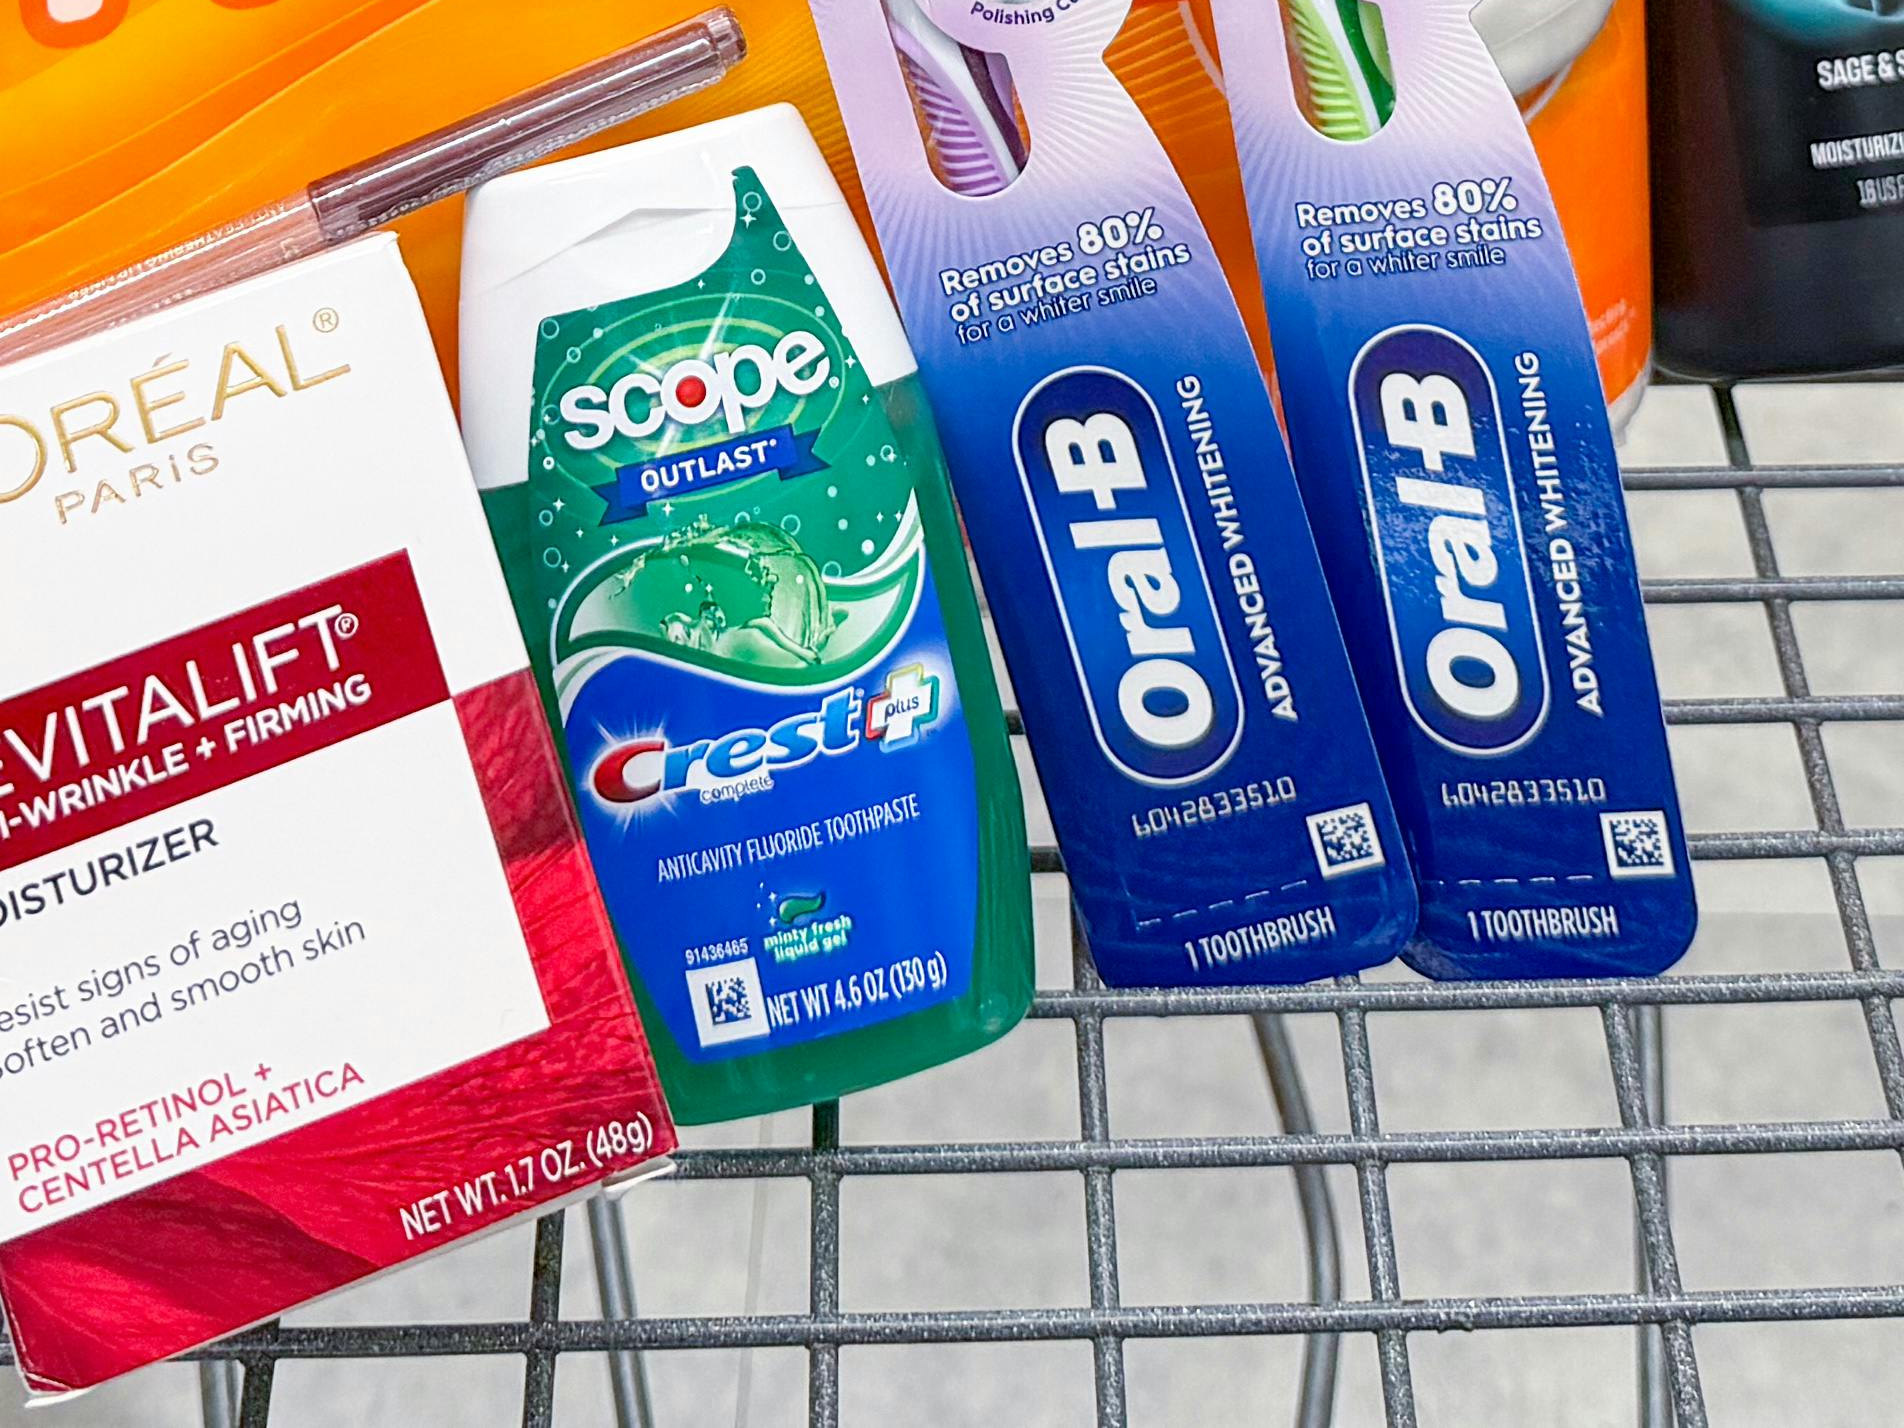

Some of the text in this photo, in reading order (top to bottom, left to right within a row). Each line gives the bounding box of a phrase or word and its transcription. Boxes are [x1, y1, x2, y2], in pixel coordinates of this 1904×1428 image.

[970, 0, 1055, 25] Polishing
[1816, 52, 1874, 91] SAGE
[1876, 51, 1895, 83] &
[1295, 176, 1518, 229] Removes 80%
[1300, 215, 1543, 257] of surface stains
[940, 206, 1165, 296] Removes 80%
[950, 242, 1190, 323] of surface stains
[1305, 243, 1506, 280] for a whiter smile
[956, 274, 1157, 346] for a whiter smile
[559, 329, 831, 450] scope
[54, 443, 220, 527] PARIS
[1175, 375, 1300, 721] ADVANCED WHITENING
[1380, 372, 1519, 718] Oral-B
[1514, 351, 1605, 717] ADVANCED WHITENING
[1044, 412, 1214, 742] Oral-B
[195, 734, 217, 762] +
[225, 672, 373, 748] FIRMING
[593, 687, 861, 804] Crest
[884, 694, 920, 723] plus
[699, 774, 774, 803] complete
[657, 792, 920, 884] ANTICAVITY FLUORIDE TOOTHPASTE
[76, 951, 162, 1010] signs
[167, 931, 204, 966] of
[208, 897, 305, 954] aging
[763, 913, 852, 952] minty fresh
[773, 932, 849, 964] liquid gel
[1185, 906, 1336, 972] 1 TOOTHBRUSH
[1467, 906, 1619, 942] 1 TOOTHBRUSH
[98, 992, 163, 1044] and
[168, 944, 297, 1024] smooth
[300, 915, 367, 964] skin
[767, 950, 949, 1028] NET WT 4.6 OZ (130 g)
[7, 1061, 274, 1184] PRO-RETINOL +
[16, 1061, 366, 1216] CENTELLA ASIATICA
[399, 1110, 654, 1242] NET WT. 1.7 OZ. (48g)
